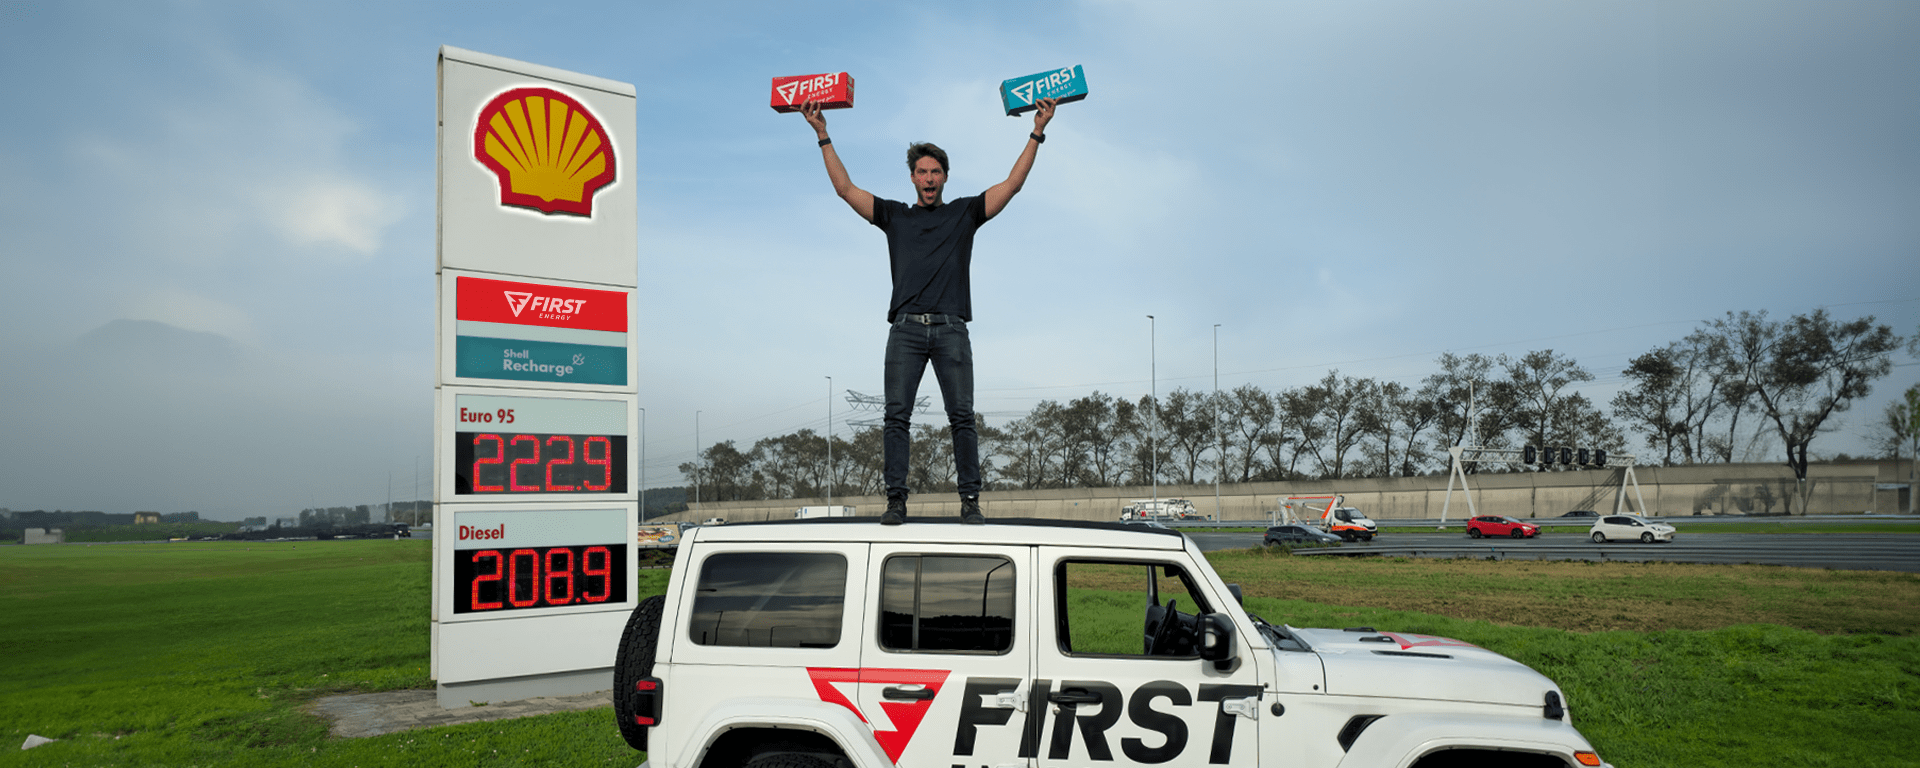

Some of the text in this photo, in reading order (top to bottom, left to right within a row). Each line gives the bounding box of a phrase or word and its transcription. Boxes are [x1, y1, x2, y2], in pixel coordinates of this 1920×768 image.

[800, 72, 841, 95] FIRST
[1036, 65, 1077, 94] FIRST
[530, 296, 587, 315] FIRST
[538, 313, 571, 321] ENERGY
[503, 349, 529, 360] Shell
[503, 359, 574, 377] Recharge
[460, 407, 515, 424] Euro 95
[473, 433, 612, 492] 222.9
[459, 523, 505, 541] Diesel
[472, 546, 611, 610] 208.9
[952, 676, 1265, 765] FIRST
